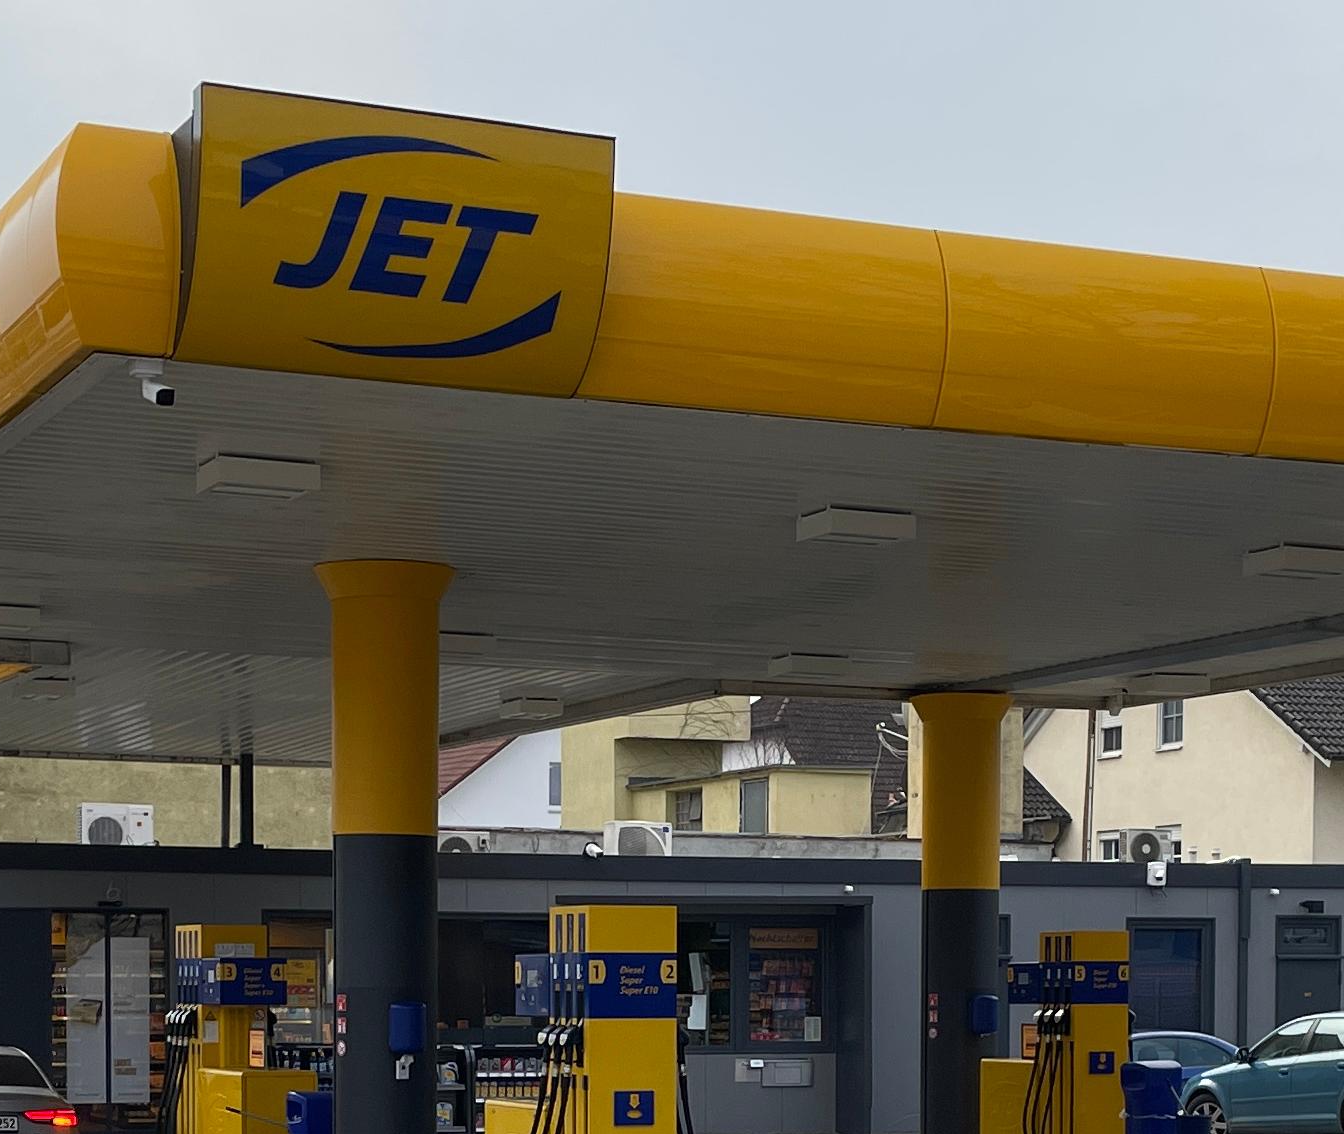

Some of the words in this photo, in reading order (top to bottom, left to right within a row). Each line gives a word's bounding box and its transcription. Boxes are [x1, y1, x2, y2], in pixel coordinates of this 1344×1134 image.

[273, 191, 539, 304] JET
[225, 966, 233, 978] 3
[273, 966, 281, 977] 4
[592, 965, 600, 979] 1
[619, 965, 646, 975] Diesel
[665, 965, 675, 979] 2
[1077, 968, 1083, 978] 5
[1120, 968, 1127, 978] 6
[619, 976, 644, 986] Super
[619, 986, 644, 997] Super
[644, 986, 659, 995] E10
